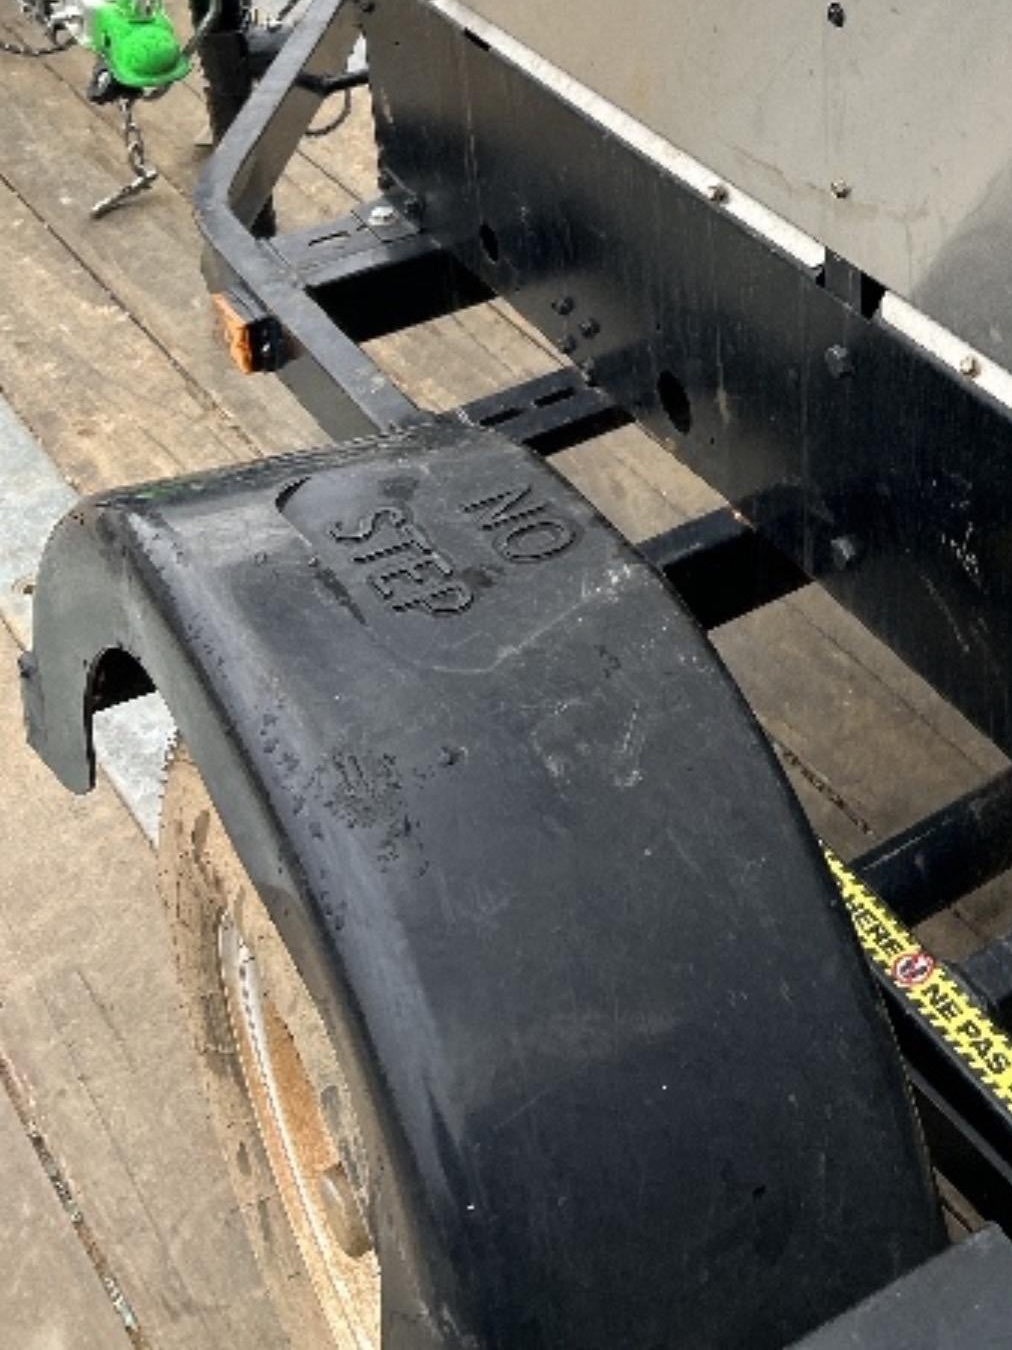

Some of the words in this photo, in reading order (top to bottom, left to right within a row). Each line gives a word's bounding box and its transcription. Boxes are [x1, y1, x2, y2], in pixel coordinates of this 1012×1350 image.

[328, 504, 476, 618] STEP
[458, 483, 584, 566] NO
[921, 982, 959, 1021] NE
[955, 1022, 1011, 1075] PAS
